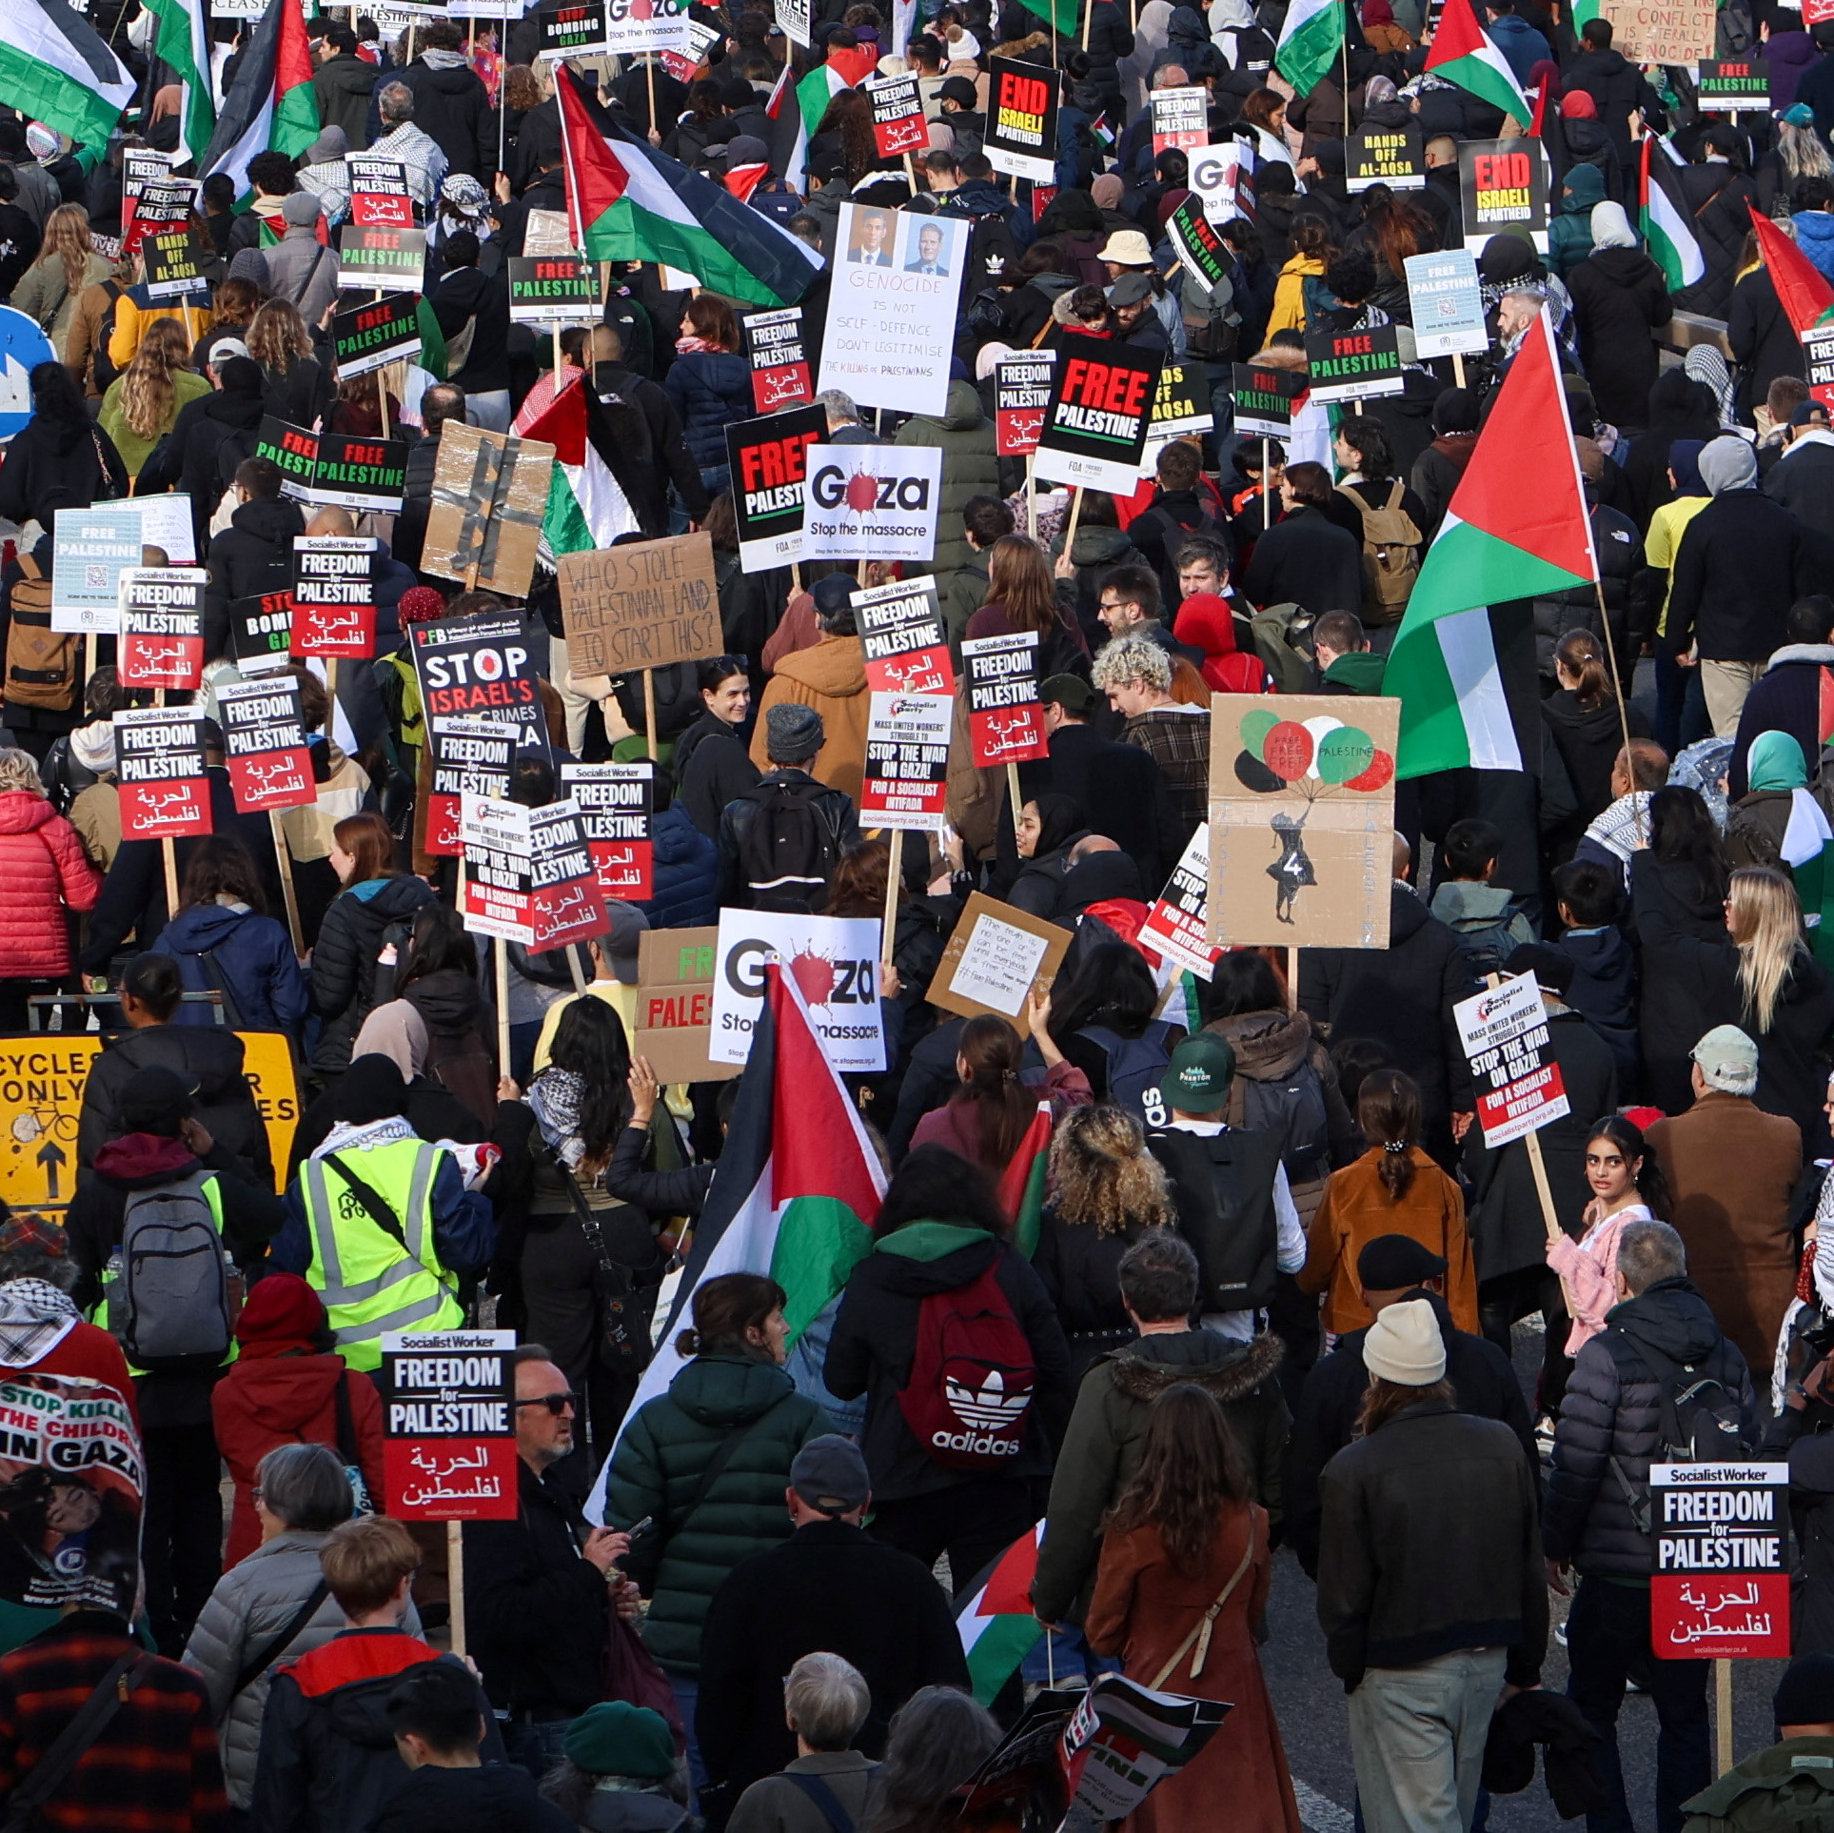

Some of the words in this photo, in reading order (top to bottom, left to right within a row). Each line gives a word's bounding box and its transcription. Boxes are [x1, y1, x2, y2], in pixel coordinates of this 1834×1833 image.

[1637, 7, 1713, 28] CONFLICT
[998, 72, 1049, 116] END
[995, 121, 1043, 148] APARTHEID
[997, 107, 1043, 135] ISRAELI
[850, 270, 942, 294] GENOCIDE
[873, 301, 887, 311] IS
[893, 303, 916, 313] NOT
[837, 317, 868, 329] SELF
[880, 321, 931, 336] DEFENCE
[837, 338, 870, 351] DON'T
[875, 342, 943, 357] LEGITIMISE
[1060, 357, 1150, 418] FREE
[1053, 402, 1139, 440] PALESTINE
[566, 553, 617, 594] WHO
[627, 545, 685, 586] STOLE
[570, 585, 666, 630] PALESTINIAN
[673, 579, 710, 615] LAND
[417, 628, 447, 645] PFB
[578, 631, 604, 671] TO
[612, 622, 662, 665] START
[667, 611, 713, 655] THIS?
[426, 647, 527, 688] STOP
[429, 679, 534, 714] ISRAEL'S
[480, 706, 537, 723] CRIMES
[2, 1079, 86, 1102] ONLY
[401, 1336, 452, 1349] Socialist
[453, 1336, 495, 1348] Worker
[394, 1357, 501, 1388] FREEDOM
[0, 1384, 62, 1414] STOP
[69, 1402, 132, 1420] KILLI
[439, 1387, 458, 1402] for
[390, 1402, 509, 1434] PALESTINE
[46, 1420, 139, 1449] CHILDR
[932, 1429, 1021, 1457] adidas
[52, 1441, 140, 1483] GAZA
[410, 1445, 489, 1476] الحرية
[1670, 1469, 1722, 1483] Socialist
[1724, 1468, 1767, 1481] Worker
[402, 1475, 501, 1506] لفلسطين
[1663, 1490, 1773, 1522] FREEDOM
[1710, 1521, 1729, 1536] for
[1659, 1538, 1781, 1569] PALESTINE
[1679, 1581, 1759, 1613] الحرية
[1670, 1612, 1771, 1644] لفلسطين
